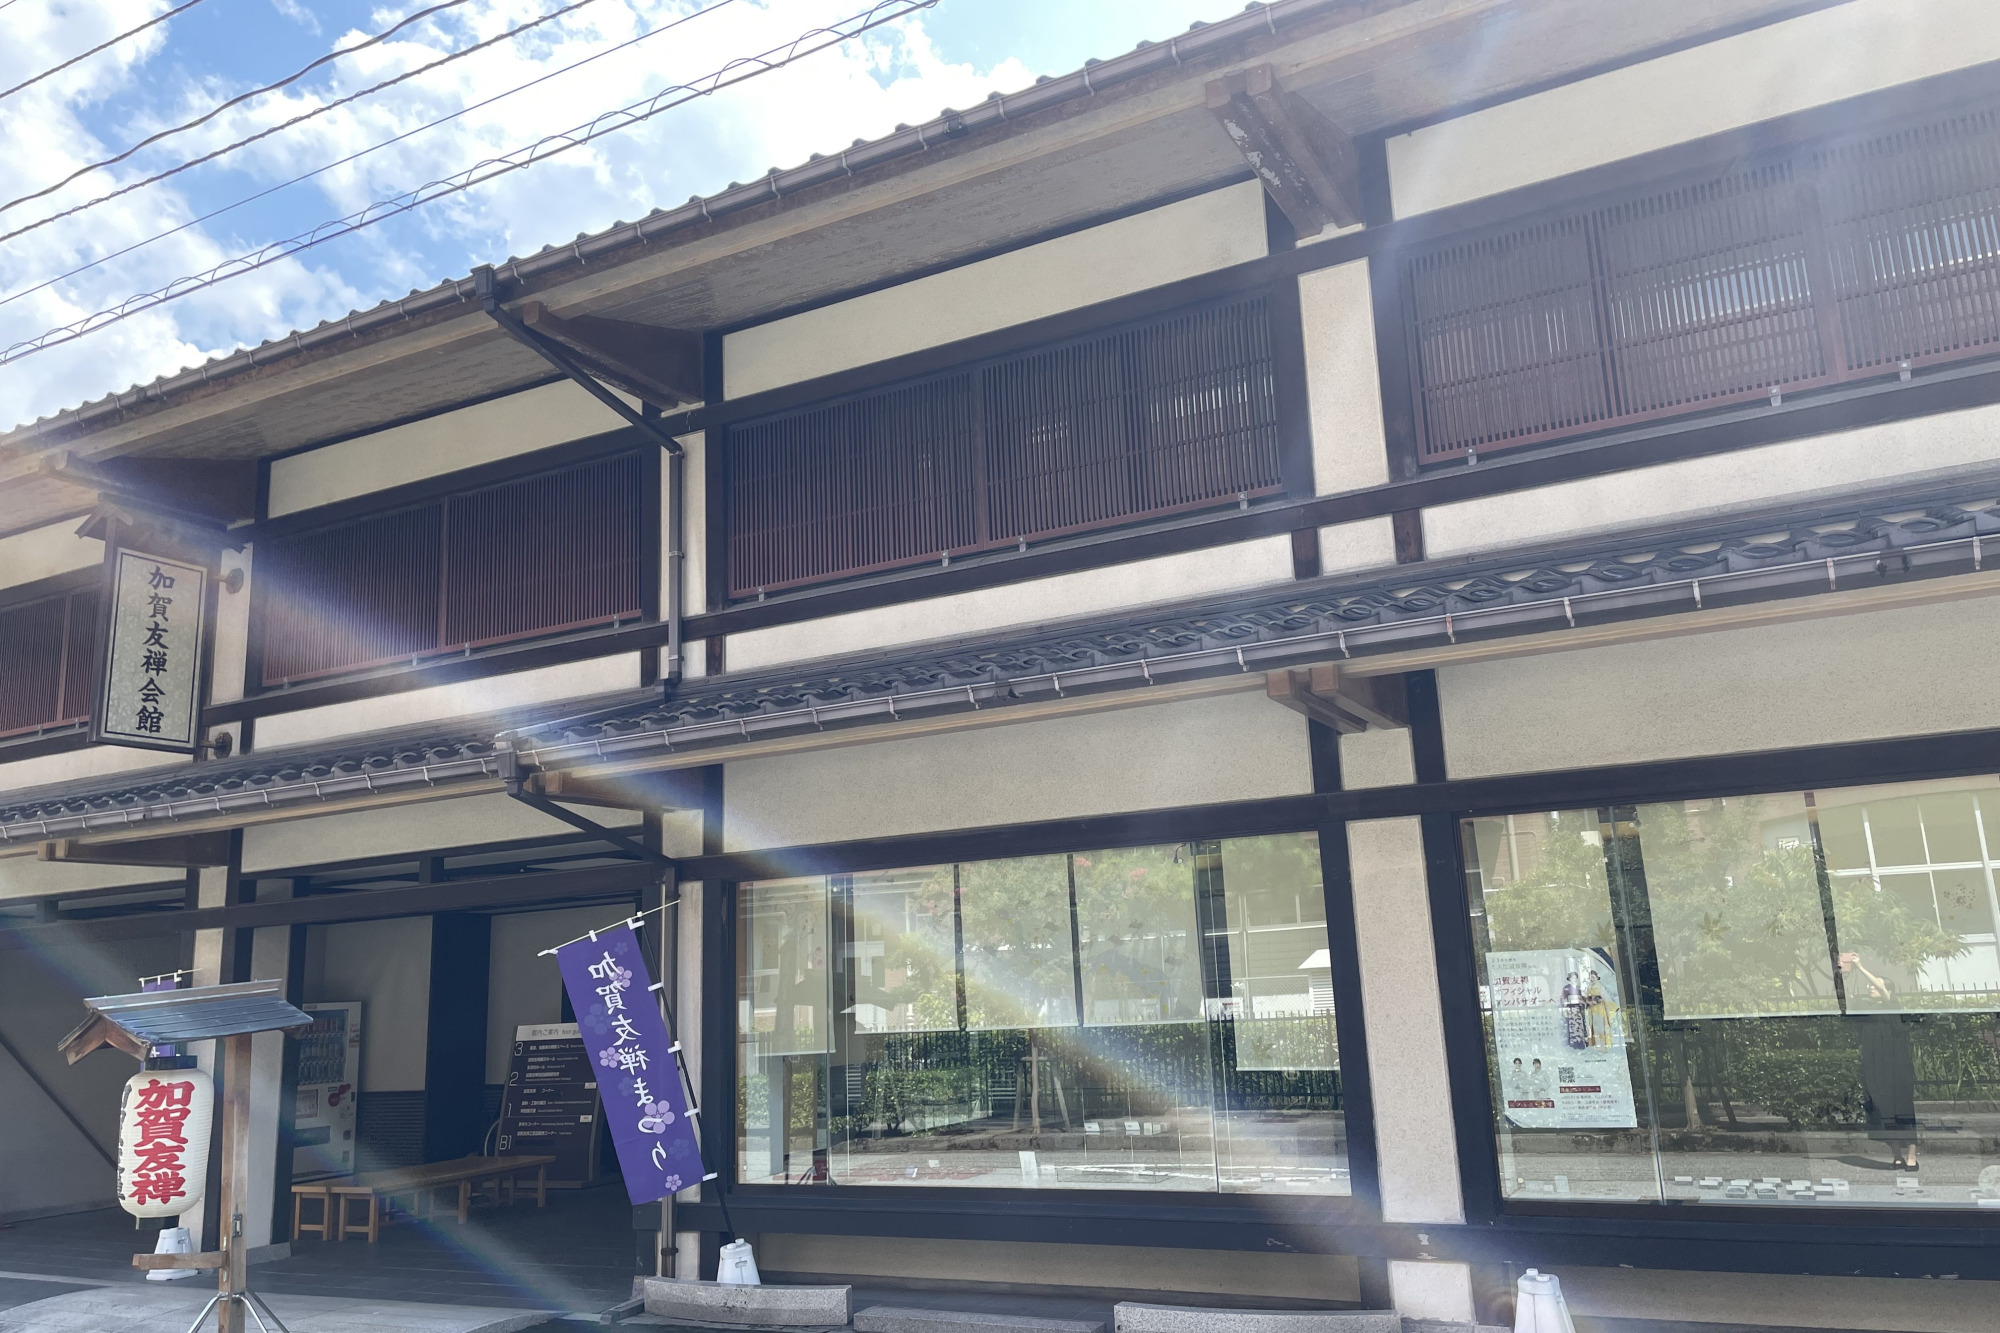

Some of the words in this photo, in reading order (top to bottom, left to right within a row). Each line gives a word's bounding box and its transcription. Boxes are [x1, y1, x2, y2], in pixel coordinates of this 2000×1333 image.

[134, 565, 176, 734] 加賀友禅会館
[514, 1041, 524, 1056] 3
[509, 1071, 519, 1086] 2
[128, 1078, 196, 1206] 加賀友禅
[499, 1135, 512, 1151] B1
